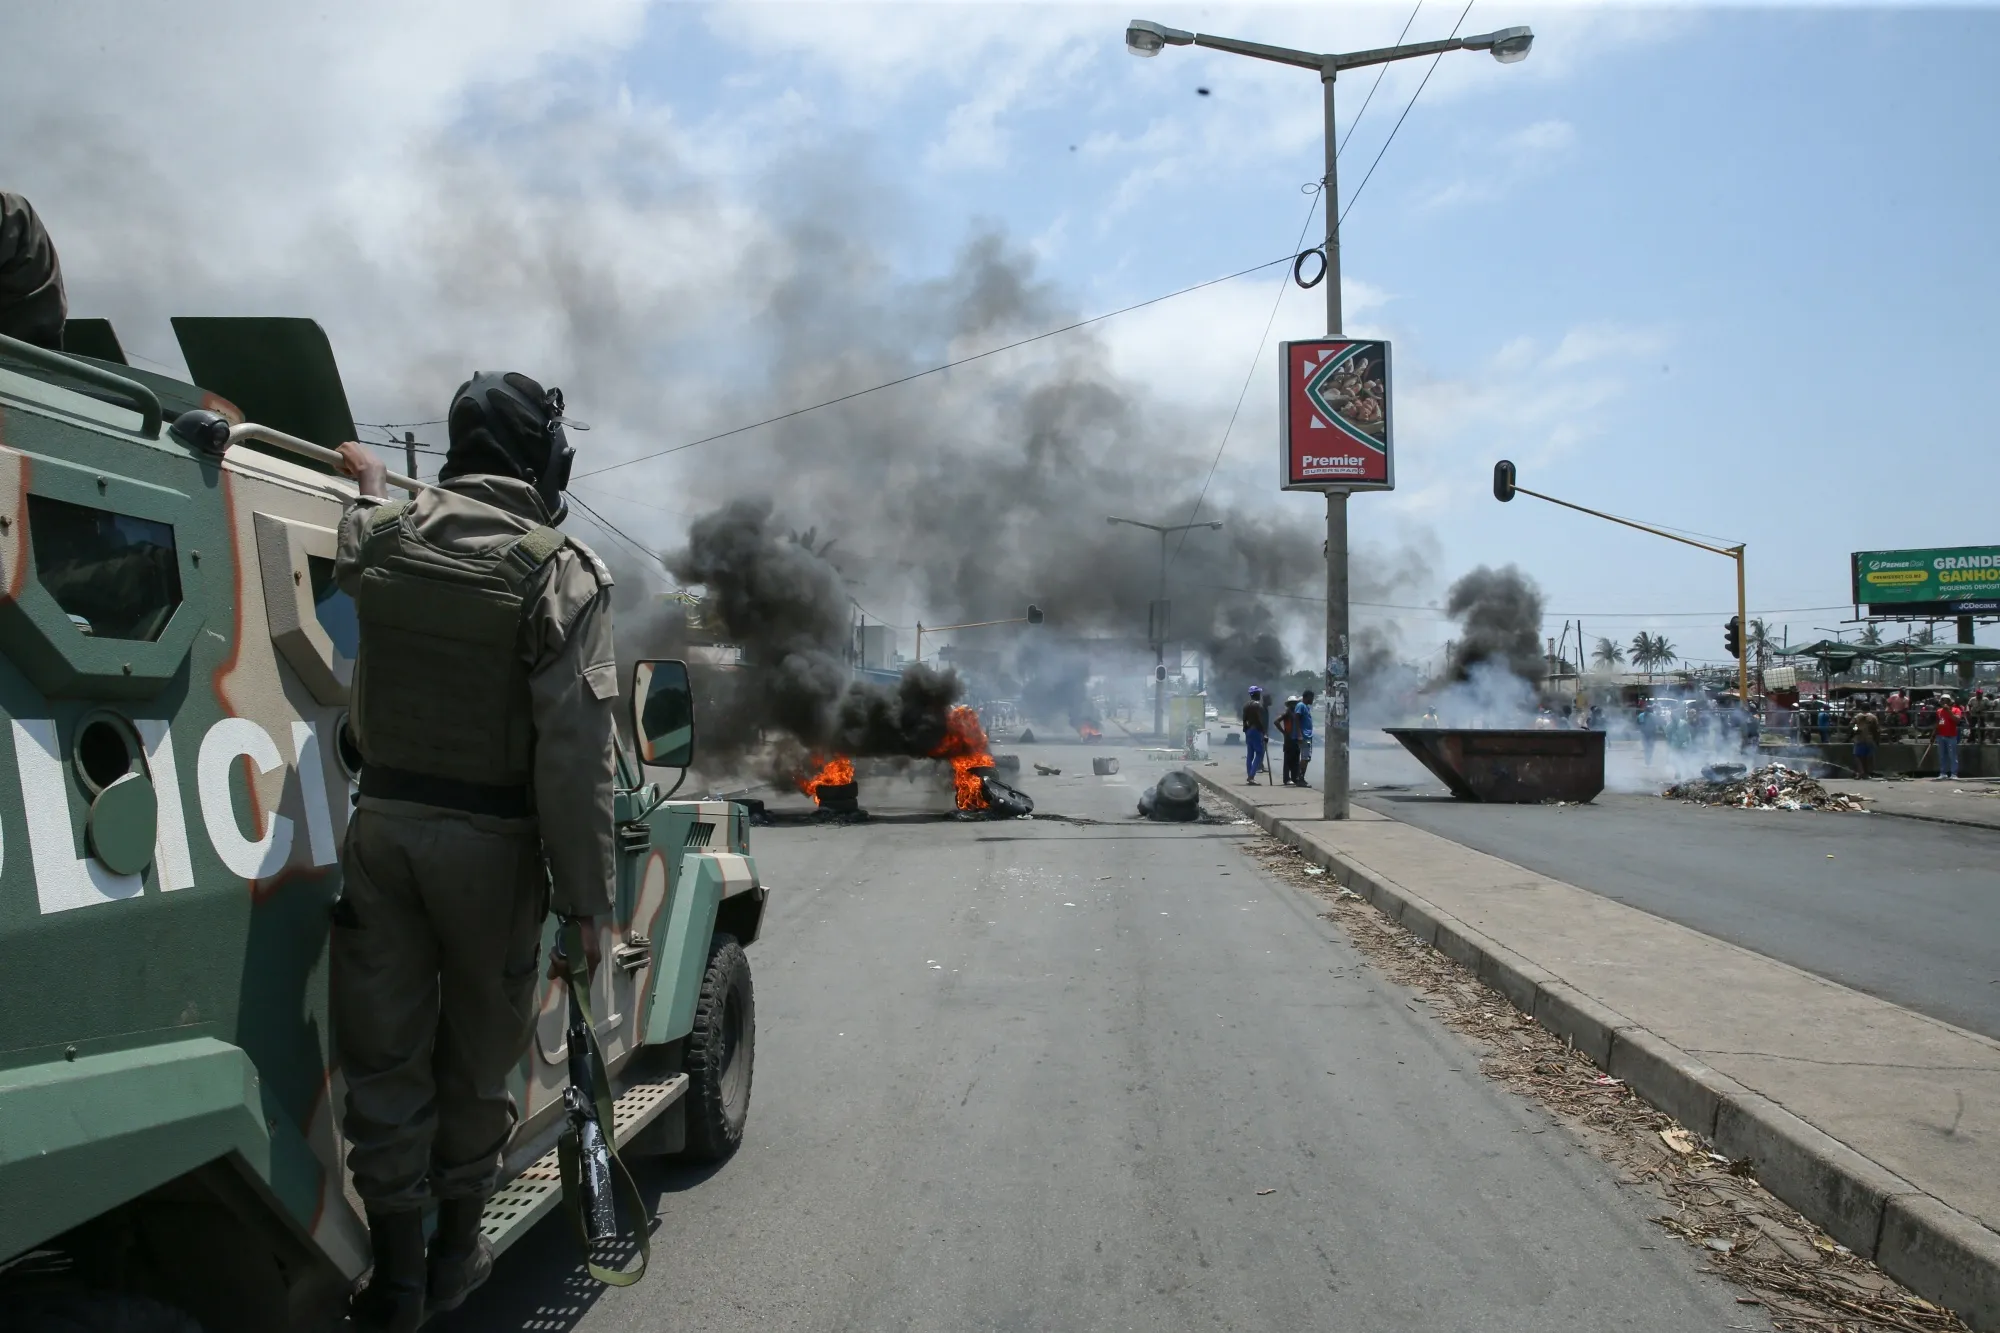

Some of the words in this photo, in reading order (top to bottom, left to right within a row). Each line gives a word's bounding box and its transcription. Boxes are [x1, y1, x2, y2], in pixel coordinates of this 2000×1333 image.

[1303, 454, 1365, 467] Premier
[1933, 556, 2000, 569] GRANDE
[1939, 569, 2000, 582] GANHO
[0, 717, 358, 915] LICI
